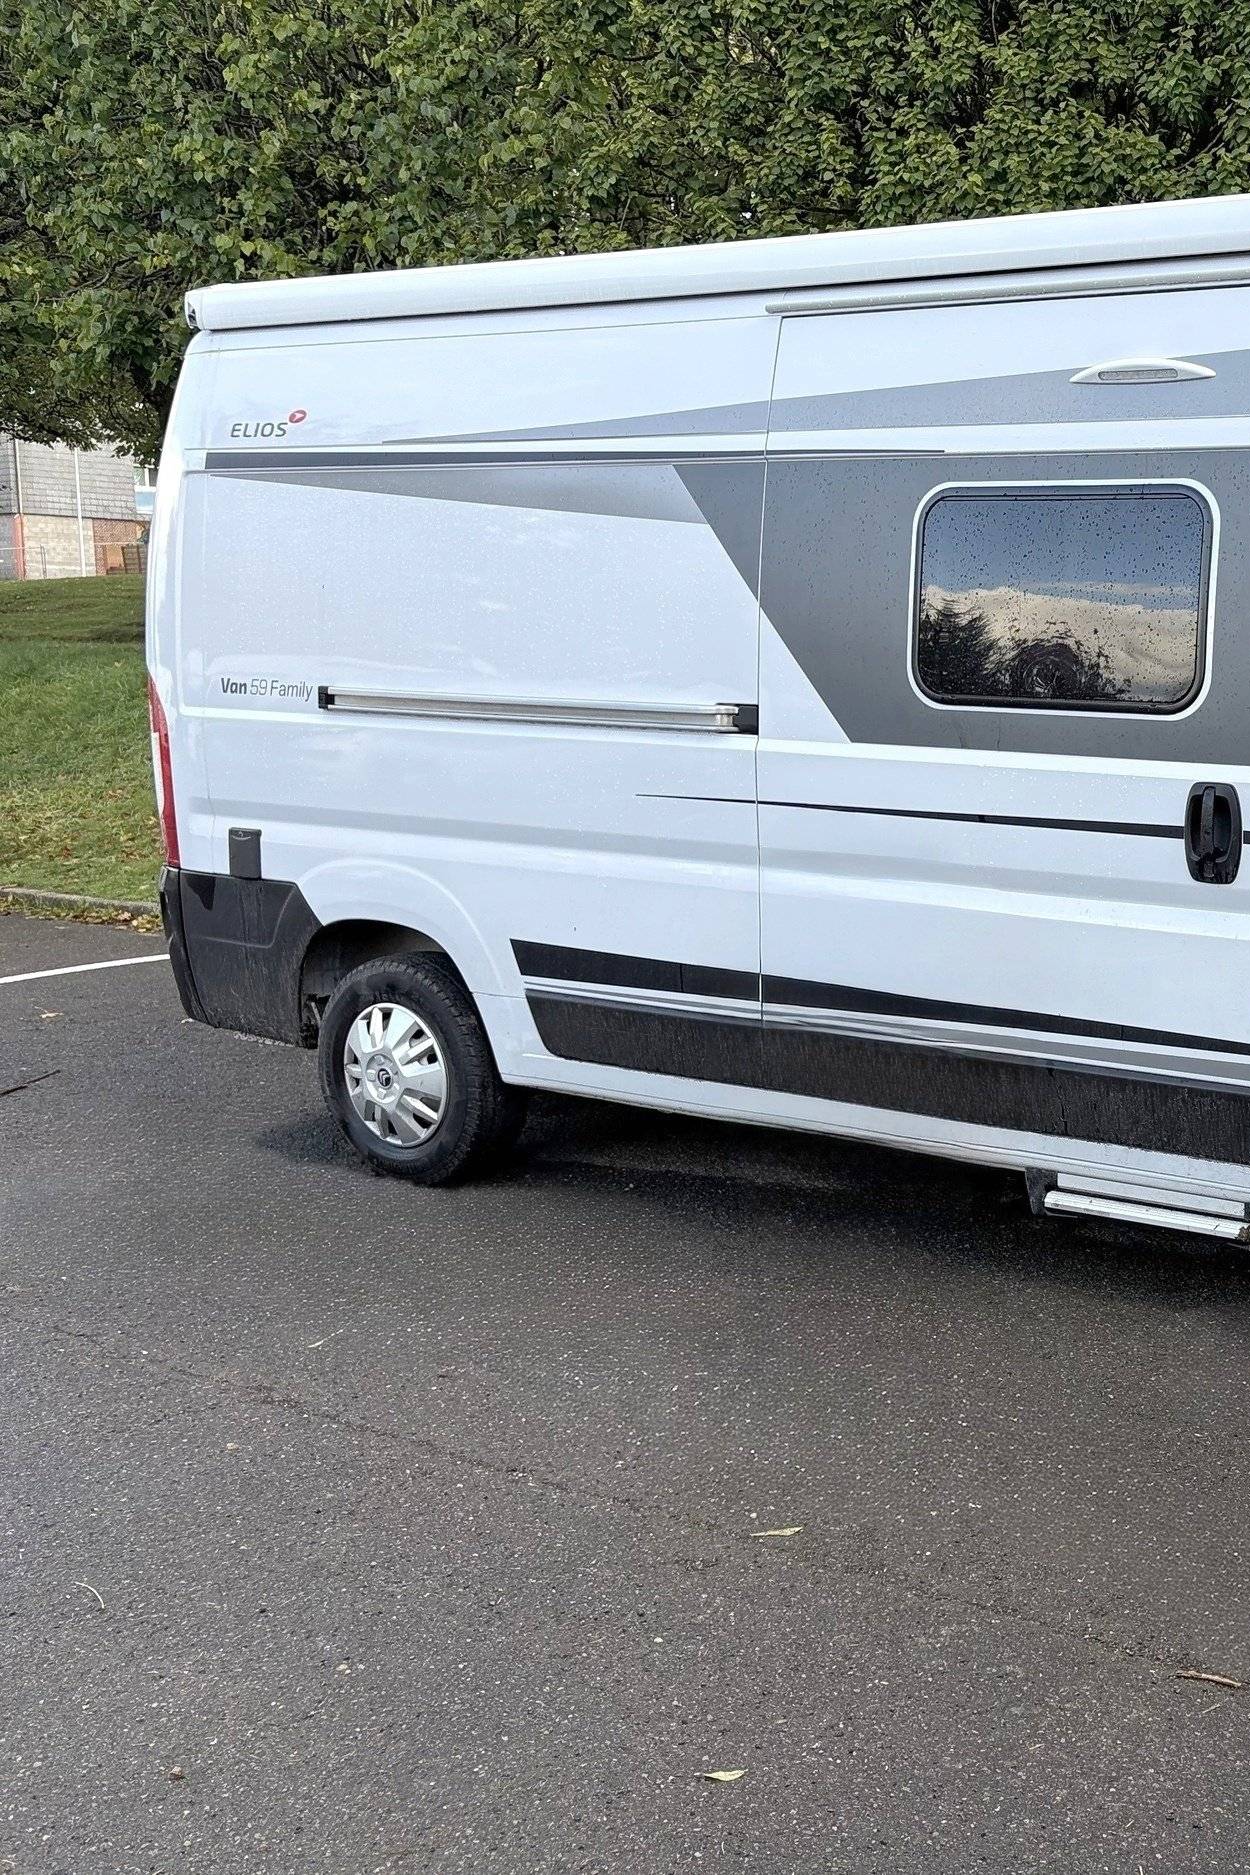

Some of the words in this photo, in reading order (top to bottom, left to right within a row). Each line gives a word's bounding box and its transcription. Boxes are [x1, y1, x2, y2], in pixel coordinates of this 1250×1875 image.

[230, 422, 288, 438] ELIOS
[220, 677, 248, 695] Van
[249, 678, 268, 696] 59
[269, 680, 314, 702] Family
